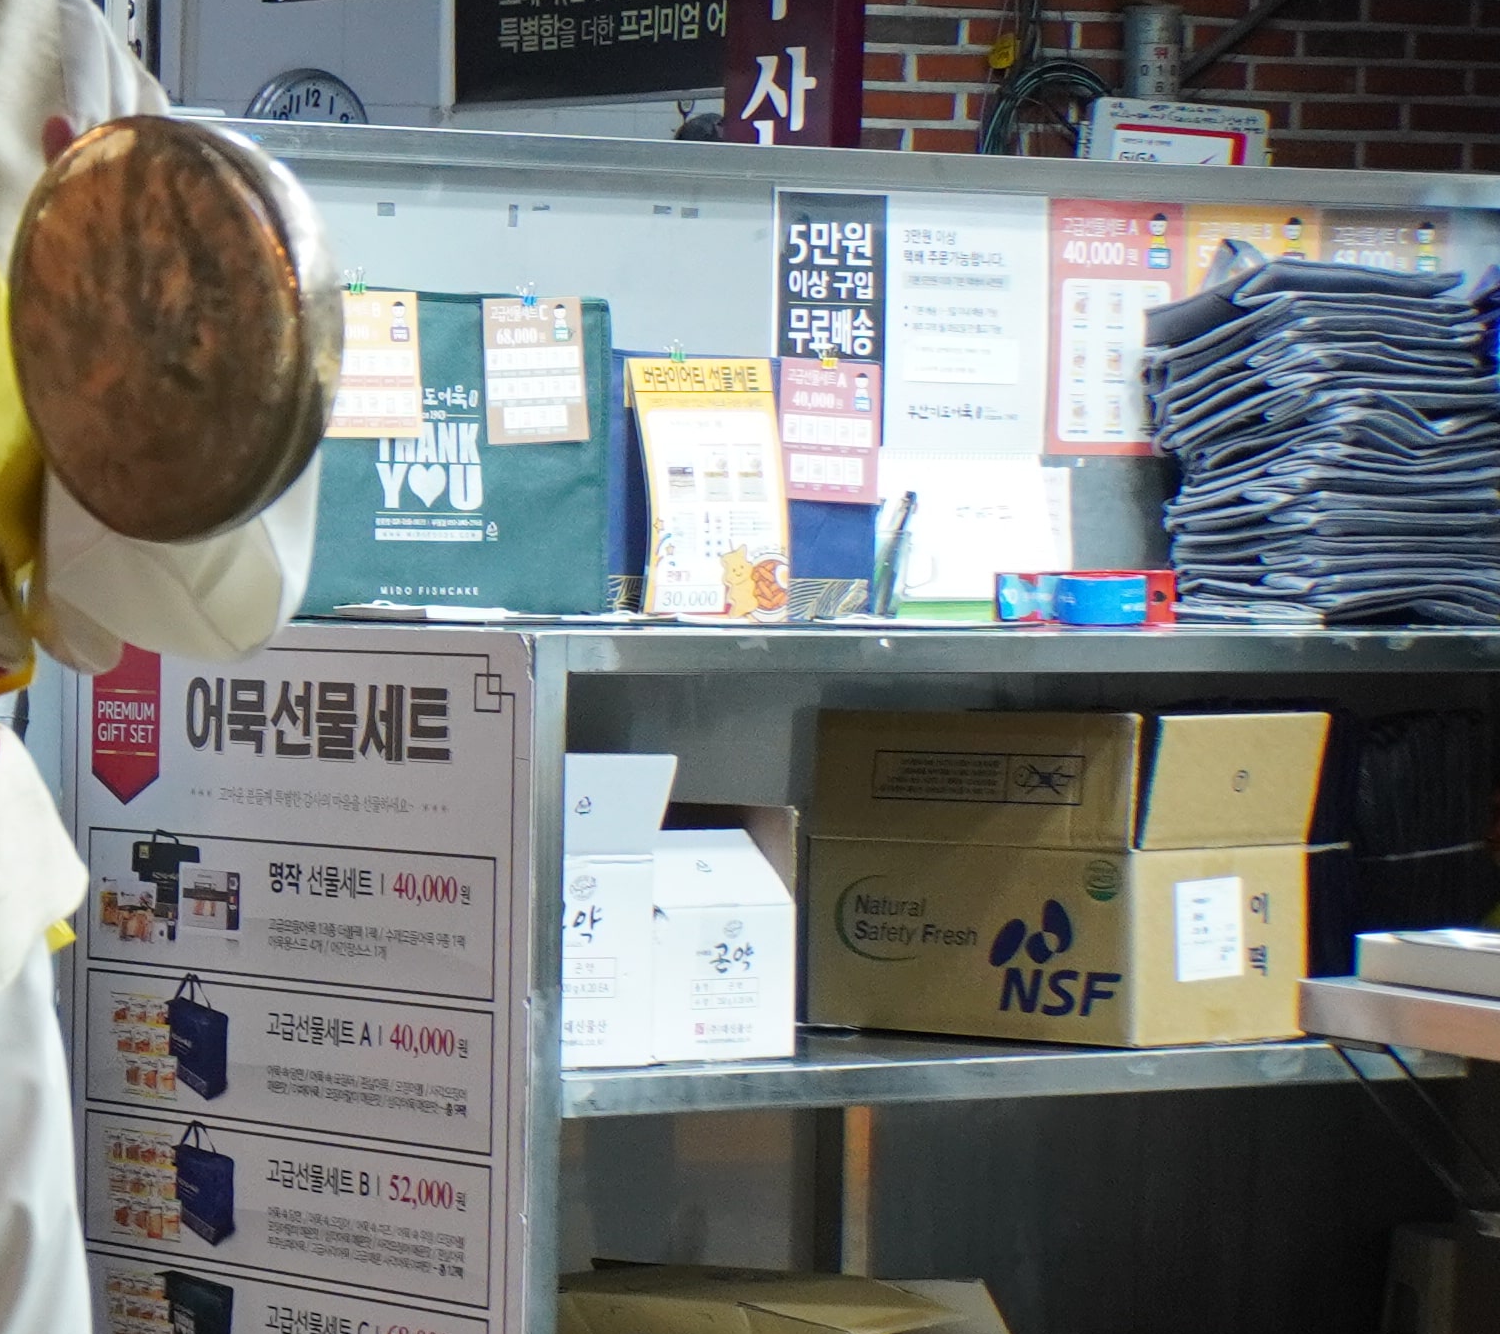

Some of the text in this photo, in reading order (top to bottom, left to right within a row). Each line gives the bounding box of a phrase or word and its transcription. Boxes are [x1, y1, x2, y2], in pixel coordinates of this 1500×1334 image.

[497, 13, 577, 54] 특별함을
[580, 13, 615, 45] 더한
[618, 3, 700, 43] 프리미엄
[902, 228, 957, 246] 3만원 이상
[1128, 218, 1140, 237] A
[787, 221, 874, 267] 5만원
[903, 249, 925, 267] 택배
[1063, 239, 1125, 267] 40,000
[787, 269, 830, 300] 이상
[832, 270, 874, 301] 구입
[495, 327, 538, 346] 68,000
[787, 307, 876, 356] 무료배송
[642, 364, 760, 393] 버라이어티 선물세트
[836, 371, 848, 388] A
[791, 392, 835, 410] 40,000
[379, 584, 480, 597] MIDO FISHCAKE
[661, 590, 719, 607] 30,000
[96, 699, 156, 722] PREMIUM
[185, 676, 452, 765] 어묵선물세트
[97, 722, 155, 746] GIFT SET
[268, 861, 472, 907] 명작 선물세트 40,000 원
[853, 892, 926, 919] Natural
[853, 919, 979, 949] Safety Fresh
[708, 941, 755, 975] 곤약
[999, 967, 1122, 1018] NSF
[266, 1011, 469, 1060] 고급선물세트 A 40,000 원
[265, 1158, 467, 1213] 고급선물세트 B 52,000 원
